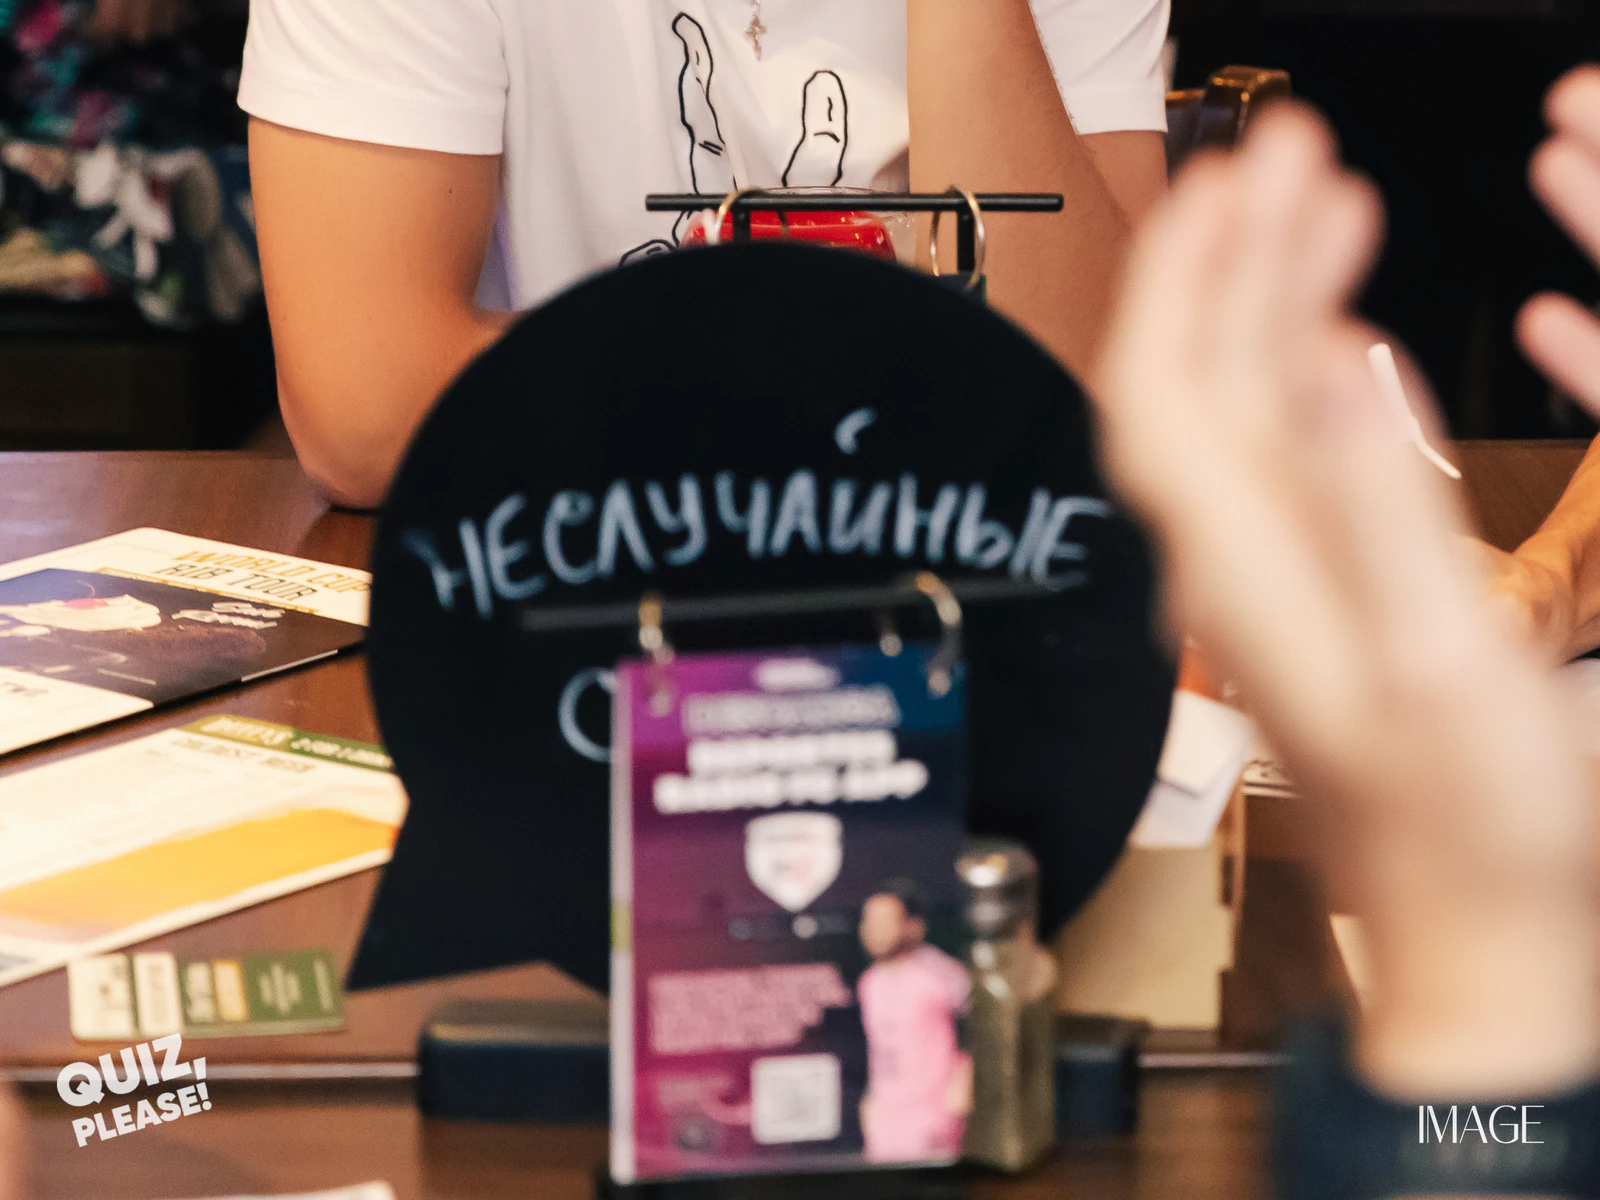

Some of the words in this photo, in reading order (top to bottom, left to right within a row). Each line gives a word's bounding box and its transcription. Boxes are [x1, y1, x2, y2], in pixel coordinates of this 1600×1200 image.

[402, 407, 1110, 620] НЕСЛУЧАЙНЫЕ
[173, 550, 317, 579] WORLD
[225, 572, 319, 601] TOUR
